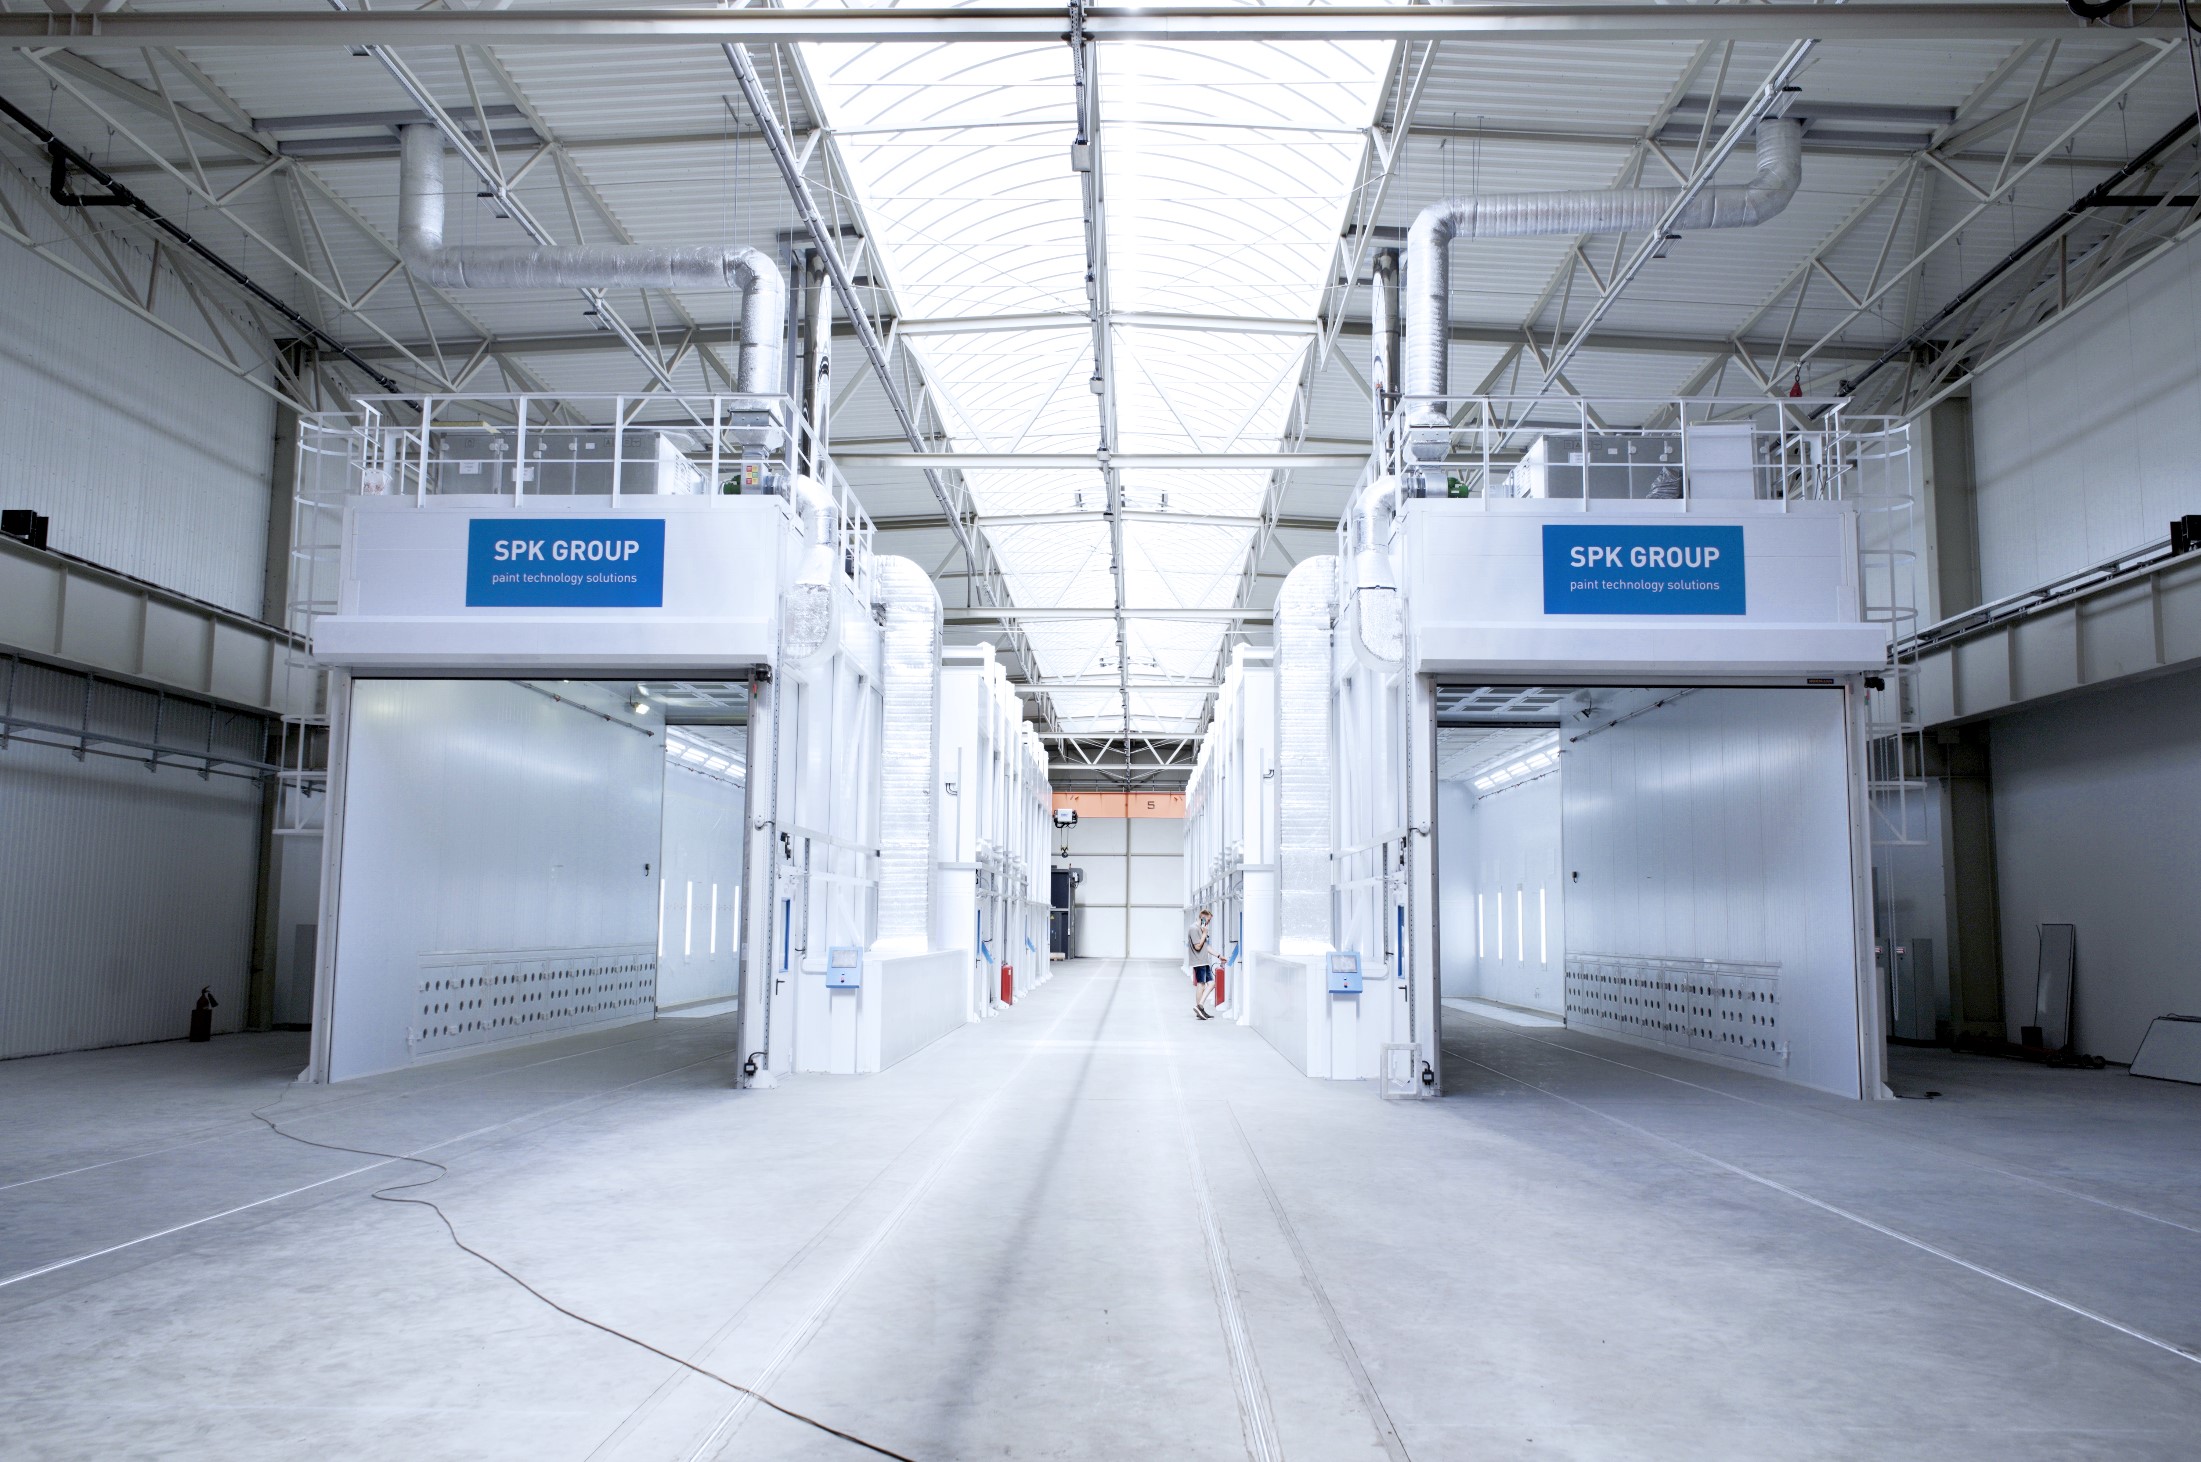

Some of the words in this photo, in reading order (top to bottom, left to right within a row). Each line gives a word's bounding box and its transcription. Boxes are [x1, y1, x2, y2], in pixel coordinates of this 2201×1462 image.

[494, 540, 545, 561] SPK
[552, 540, 640, 561] GROUP
[1570, 546, 1623, 568] SPK
[1630, 546, 1720, 568] GROUP
[492, 572, 520, 585] paint
[523, 572, 583, 585] technology
[586, 572, 637, 583] solutions
[1570, 579, 1598, 592] paint
[1602, 579, 1664, 592] technology
[1667, 579, 1720, 590] solutions
